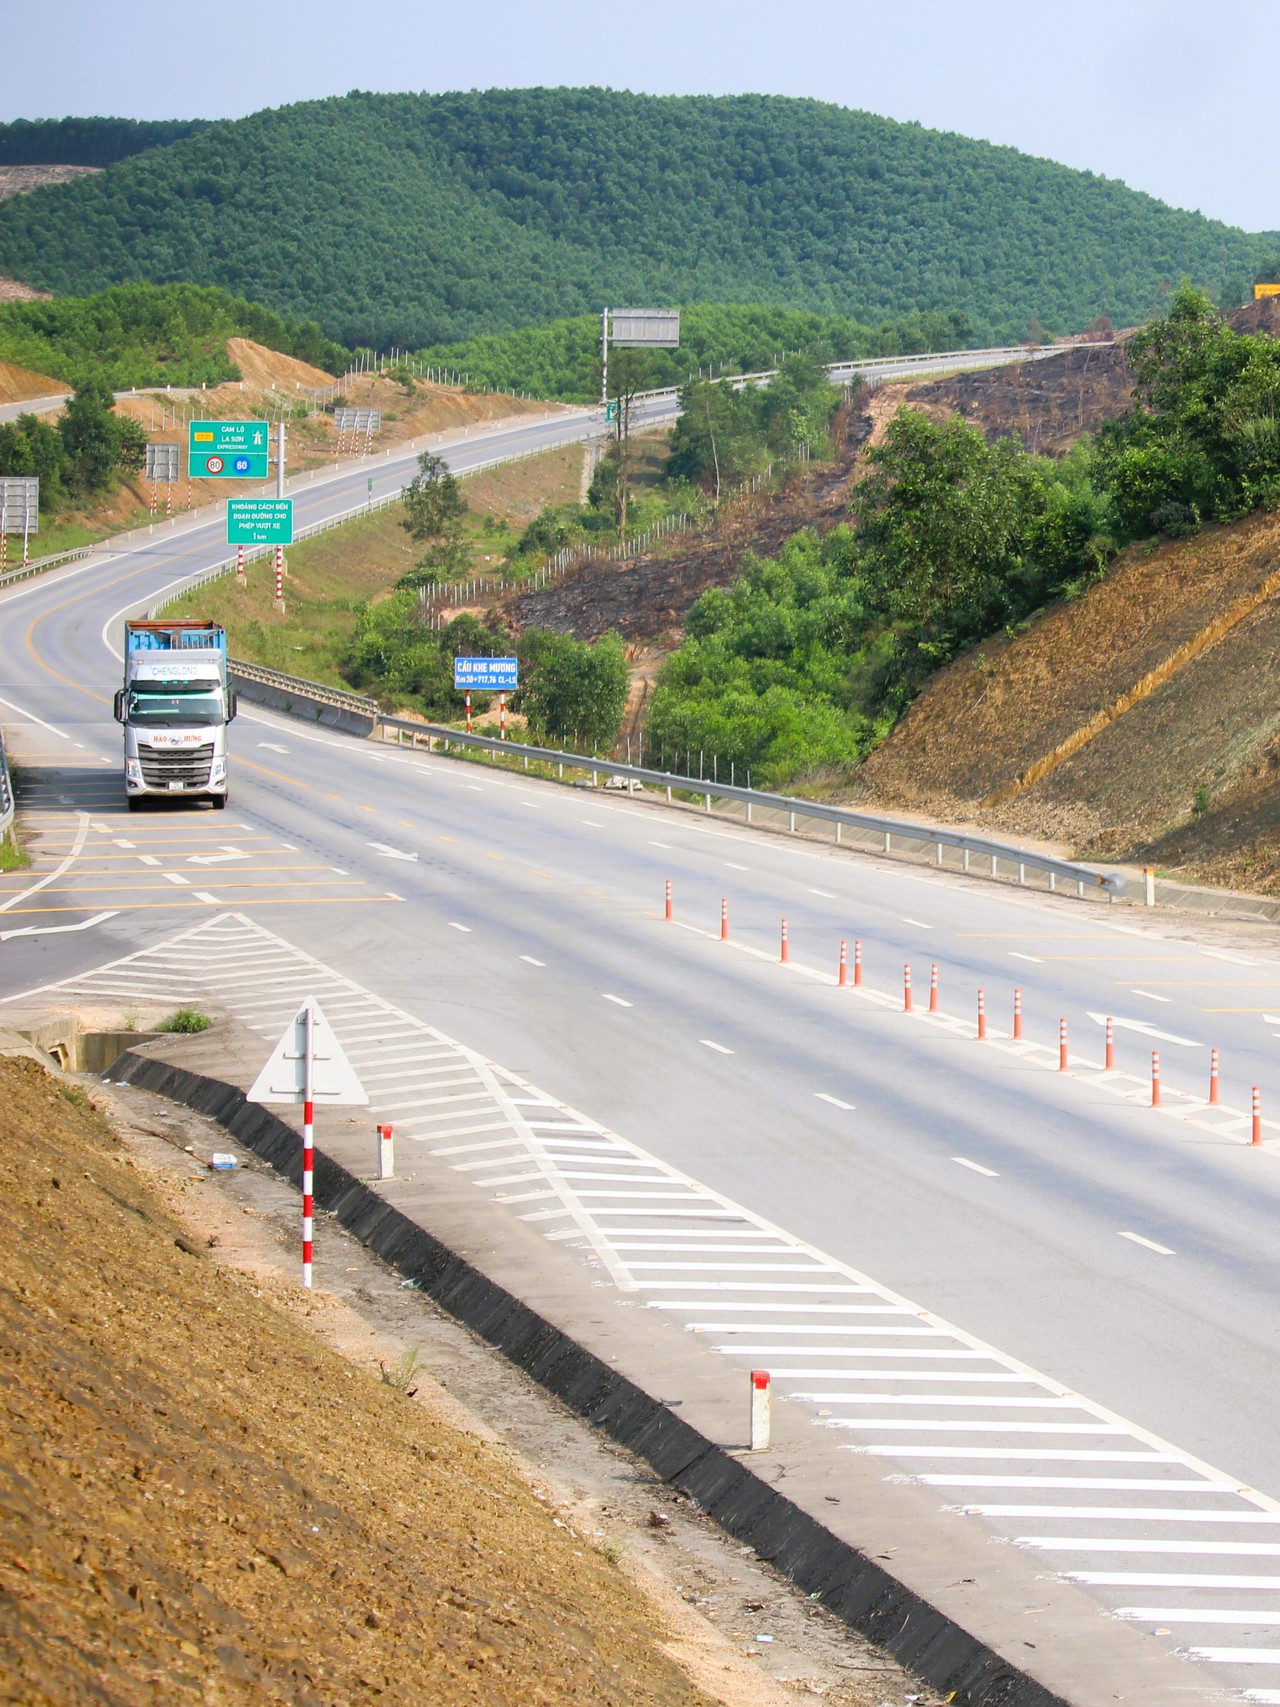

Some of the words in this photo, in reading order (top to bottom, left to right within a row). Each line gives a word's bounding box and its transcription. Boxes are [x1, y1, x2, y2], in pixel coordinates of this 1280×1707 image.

[210, 461, 221, 470] 80
[236, 461, 247, 470] 60
[258, 502, 275, 510] CÁCH
[272, 522, 281, 530] XE
[152, 667, 198, 676] CHENGLONG
[473, 662, 488, 673] KHE
